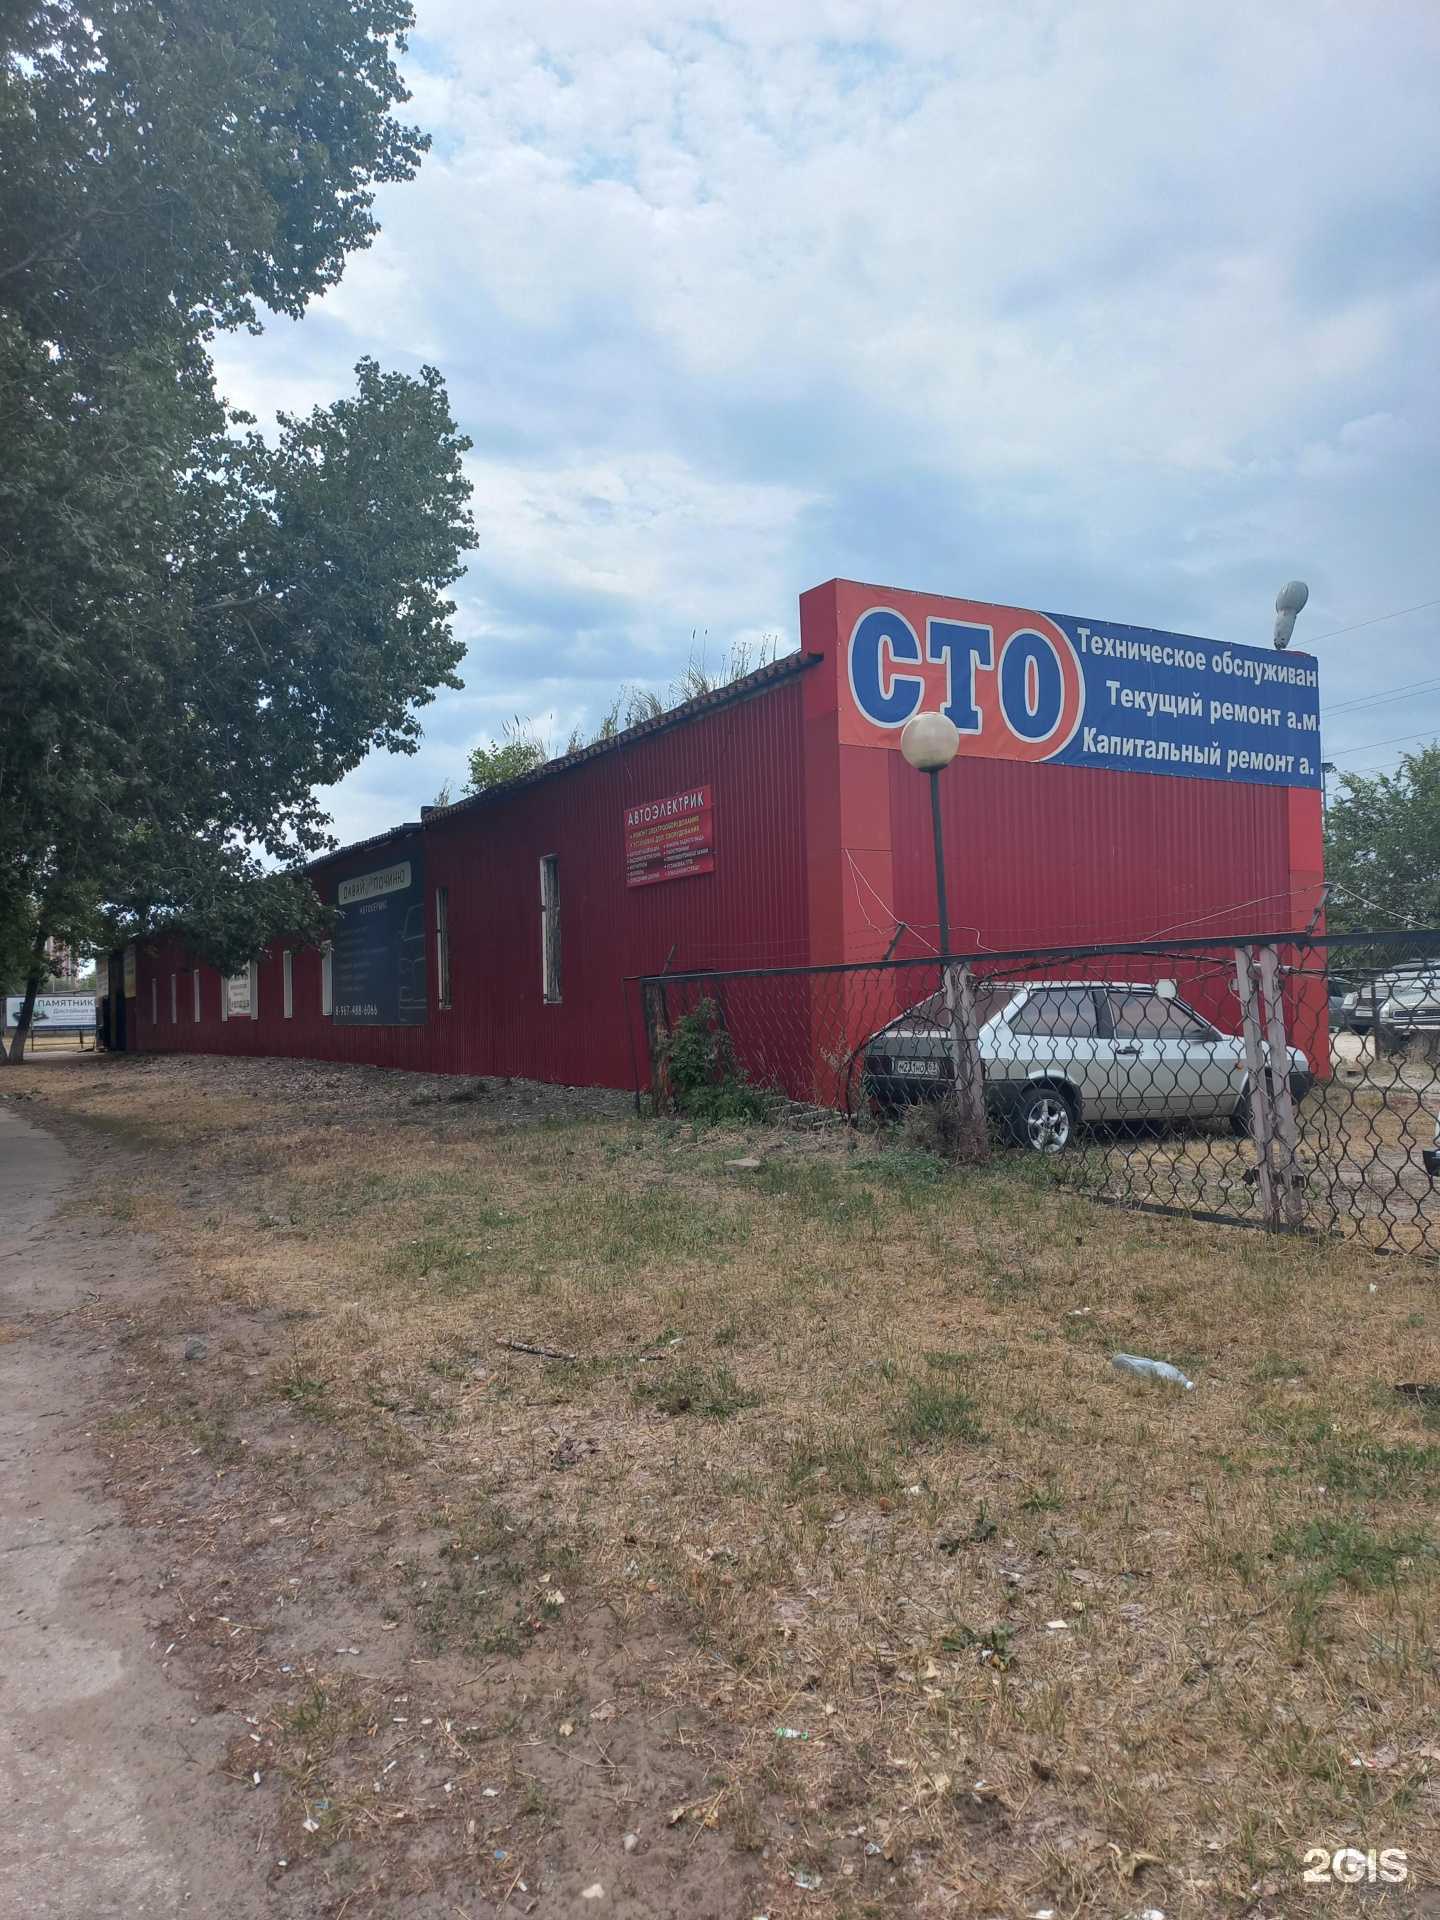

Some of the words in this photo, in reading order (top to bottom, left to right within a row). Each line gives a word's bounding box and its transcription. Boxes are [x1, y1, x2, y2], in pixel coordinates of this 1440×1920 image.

[848, 606, 1066, 743] СТО
[1077, 626, 1206, 671] Техническое
[1211, 650, 1318, 688] обслуживан
[1106, 679, 1203, 718] Текущий
[1210, 699, 1281, 727] ремонт
[1083, 726, 1222, 768] Капитальный
[1226, 748, 1295, 774] ремонт
[1299, 757, 1315, 775] а.
[628, 791, 704, 826] АВТОЭЛЕКТРИК
